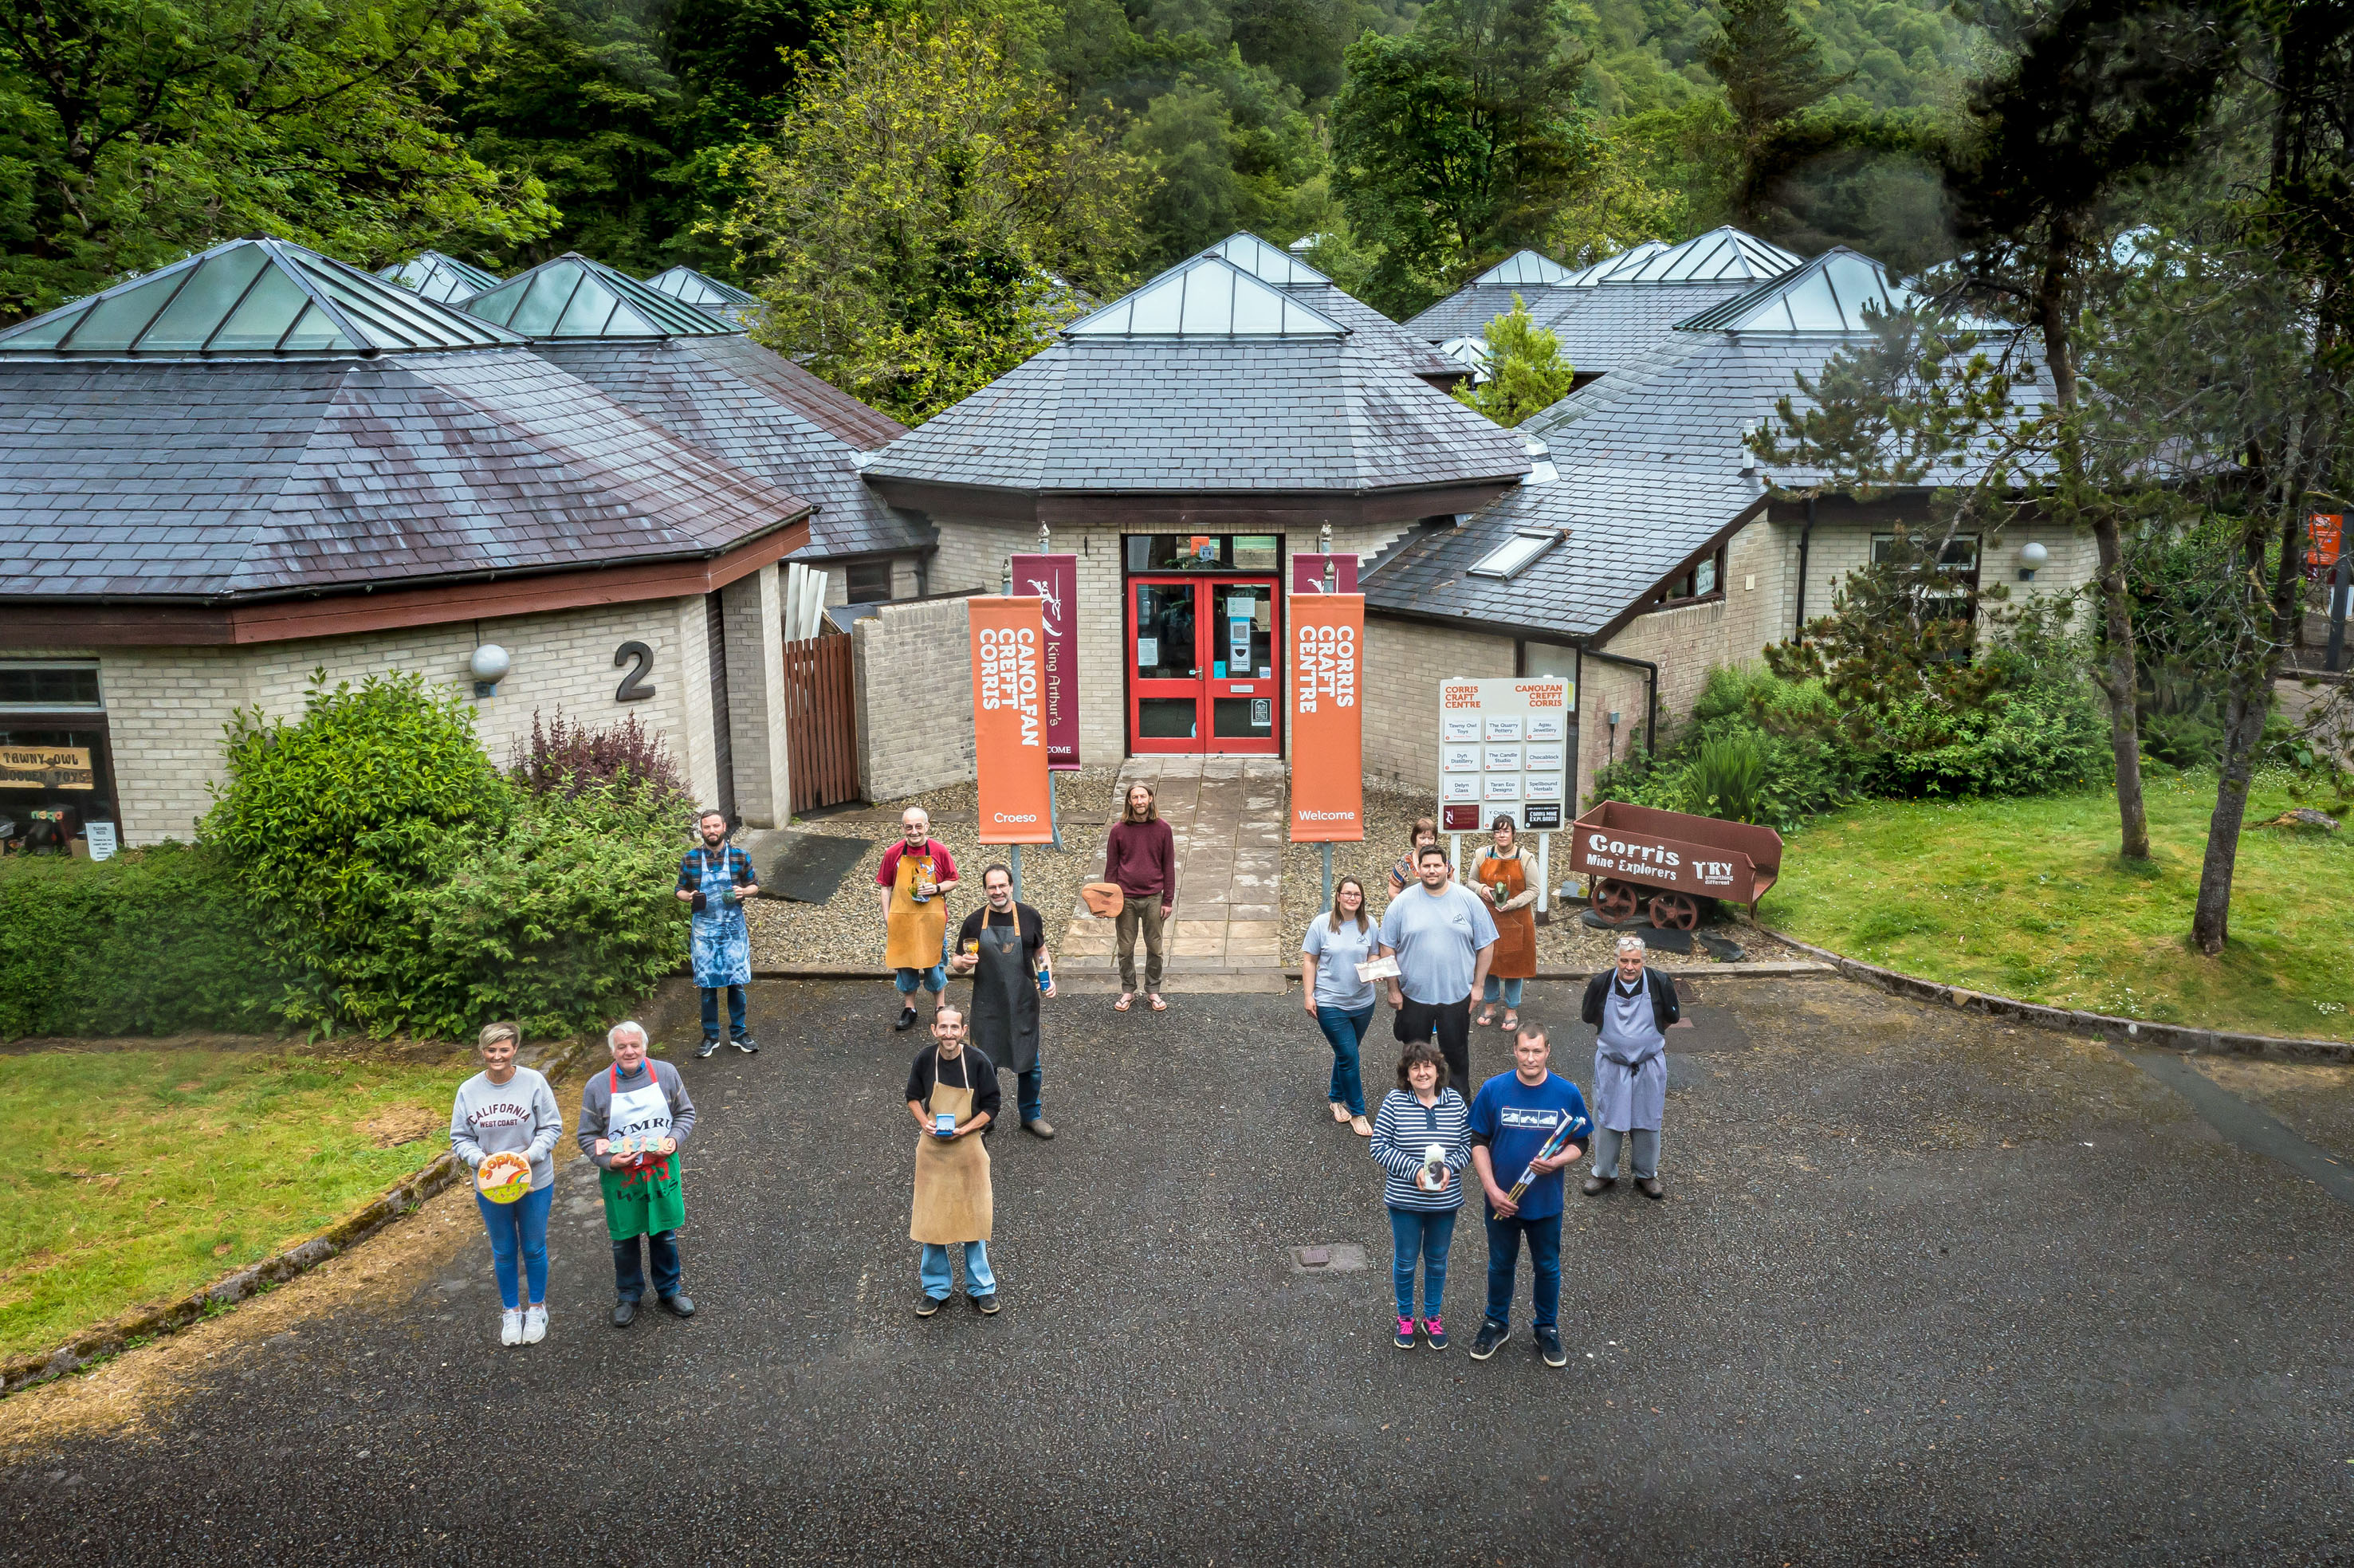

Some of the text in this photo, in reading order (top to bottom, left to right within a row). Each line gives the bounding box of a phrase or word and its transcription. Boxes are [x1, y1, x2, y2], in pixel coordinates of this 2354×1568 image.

[615, 641, 655, 701] 2
[980, 628, 1000, 710] CORRIS
[998, 628, 1018, 709] CREFFT
[1046, 642, 1062, 726] King Arthur's
[1299, 625, 1317, 713] CENTRE
[1318, 625, 1335, 698] CRAFT
[1337, 625, 1354, 707] CORRIS
[1017, 628, 1039, 746] CANOLFAN
[3, 753, 78, 764] TAWNY OWL
[994, 812, 1037, 823] Croeso
[1299, 811, 1354, 821] Welcome
[1586, 854, 1676, 881] Mine Explorers
[1589, 834, 1680, 866] Corris
[1692, 861, 1733, 879] TRY
[468, 1103, 530, 1125] CALIFORNIA
[479, 1153, 526, 1180] Sophie
